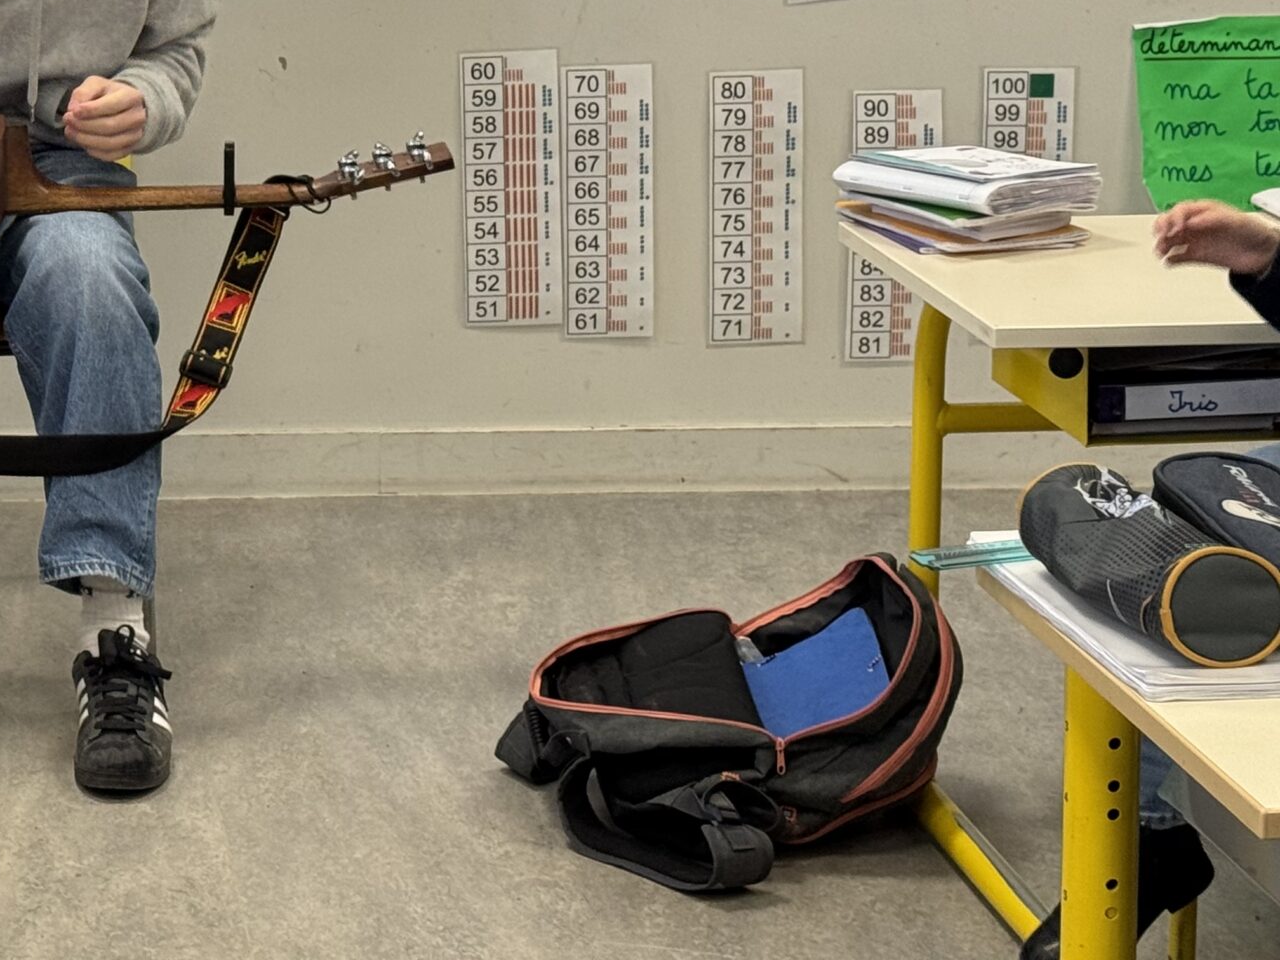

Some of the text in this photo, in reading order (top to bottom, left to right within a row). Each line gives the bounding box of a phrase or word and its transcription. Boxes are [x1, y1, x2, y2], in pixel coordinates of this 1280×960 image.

[471, 63, 495, 80] 60
[575, 75, 599, 92] 70
[721, 82, 745, 99] 80
[993, 78, 1025, 93] 100
[1164, 68, 1280, 100] ma ta
[472, 89, 496, 107] 59
[575, 102, 599, 119] 69
[864, 100, 888, 117] 90
[995, 104, 1020, 121] 99
[473, 116, 496, 133] 58
[722, 109, 745, 126] 79
[575, 129, 599, 146] 68
[864, 127, 888, 144] 89
[1155, 120, 1227, 140] mon
[722, 135, 745, 152] 78
[994, 131, 1018, 148] 98
[473, 143, 497, 159] 57
[575, 156, 599, 172] 67
[722, 162, 745, 178] 77
[474, 169, 497, 186] 56
[1161, 165, 1213, 182] mes
[575, 182, 599, 199] 66
[722, 188, 745, 205] 76
[474, 196, 498, 213] 55
[575, 208, 599, 225] 65
[721, 214, 745, 231] 75
[475, 222, 498, 239] 54
[576, 235, 599, 252] 64
[721, 241, 745, 257] 74
[475, 249, 499, 266] 53
[576, 261, 600, 278] 63
[721, 267, 745, 284] 73
[476, 275, 499, 292] 52
[576, 288, 599, 304] 62
[721, 293, 744, 310] 72
[860, 285, 884, 301] 83
[476, 301, 496, 317] 51
[576, 314, 596, 329] 61
[721, 320, 741, 336] 71
[859, 311, 883, 328] 82
[859, 337, 880, 353] 81
